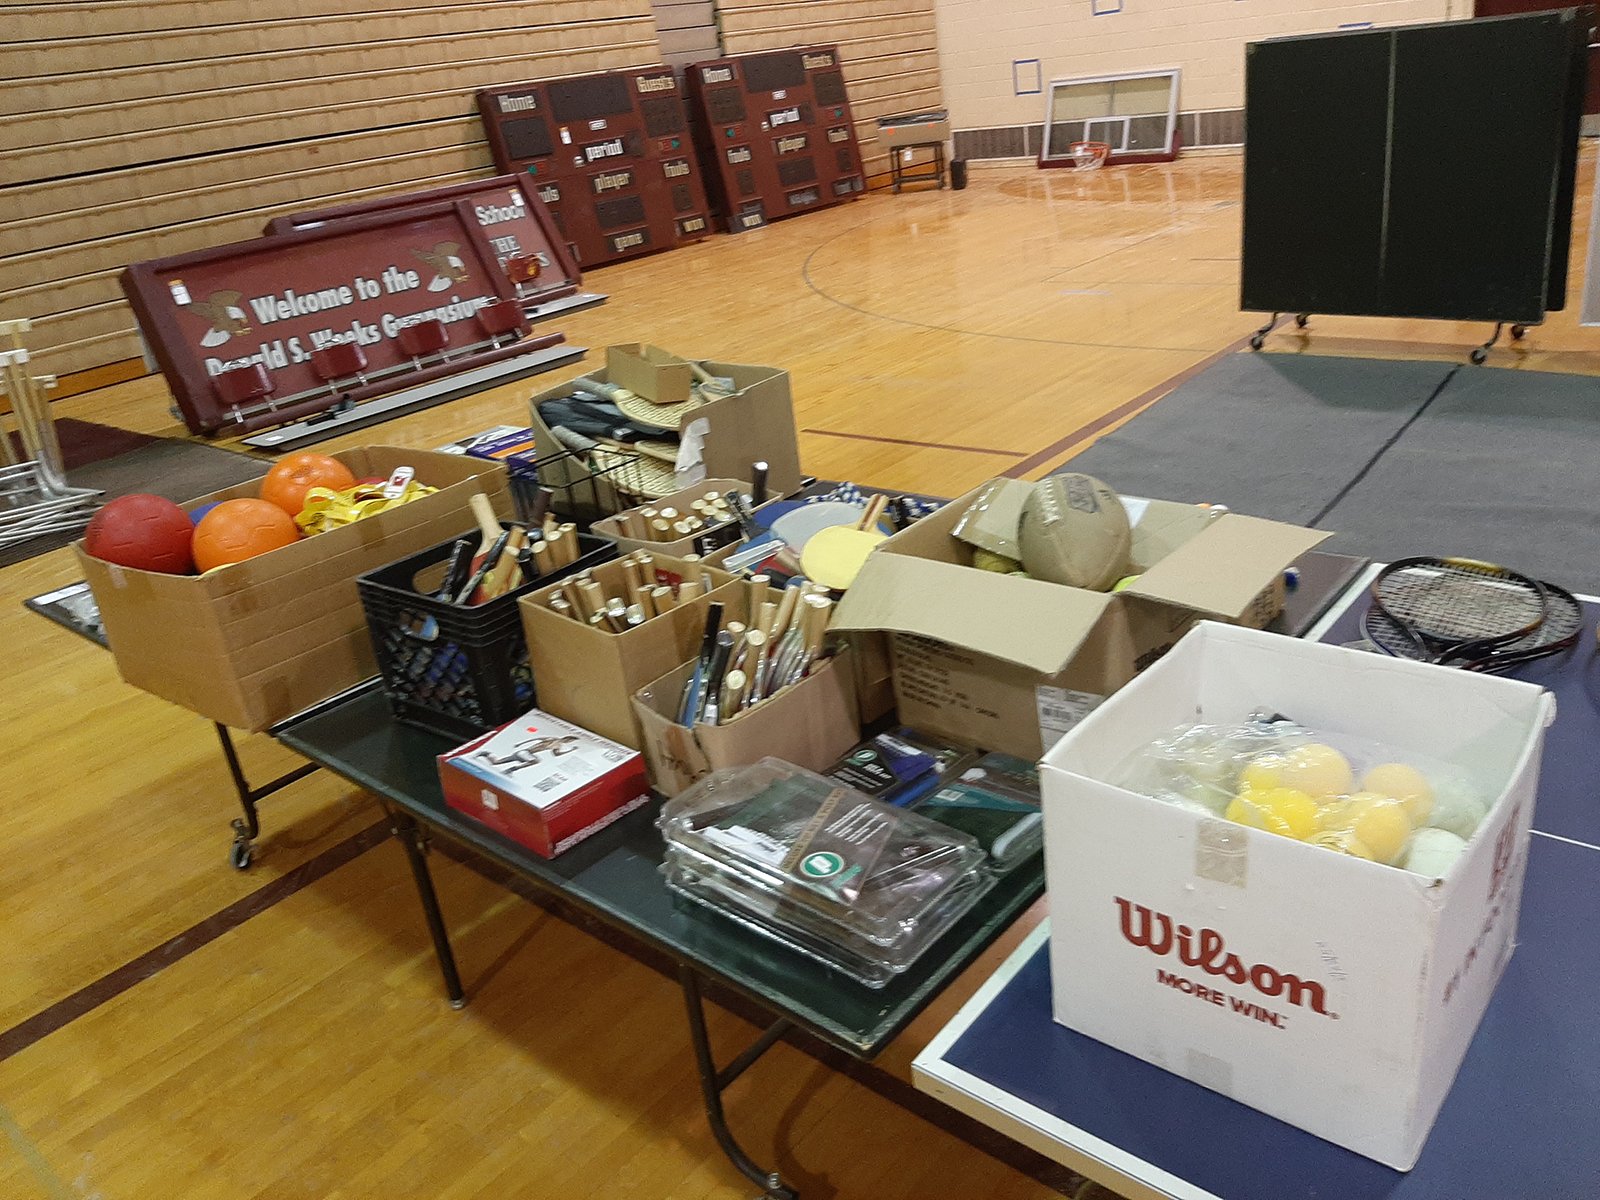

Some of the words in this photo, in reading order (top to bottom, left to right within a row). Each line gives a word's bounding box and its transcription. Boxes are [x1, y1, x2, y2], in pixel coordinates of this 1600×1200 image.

[584, 138, 624, 162] period
[538, 186, 560, 204] uls
[594, 172, 630, 193] player
[250, 285, 354, 324] Welcome
[354, 277, 381, 300] to
[382, 265, 421, 294] the
[287, 337, 312, 363] S.
[1113, 896, 1329, 1016] Wilson
[1156, 968, 1226, 1007] MORE
